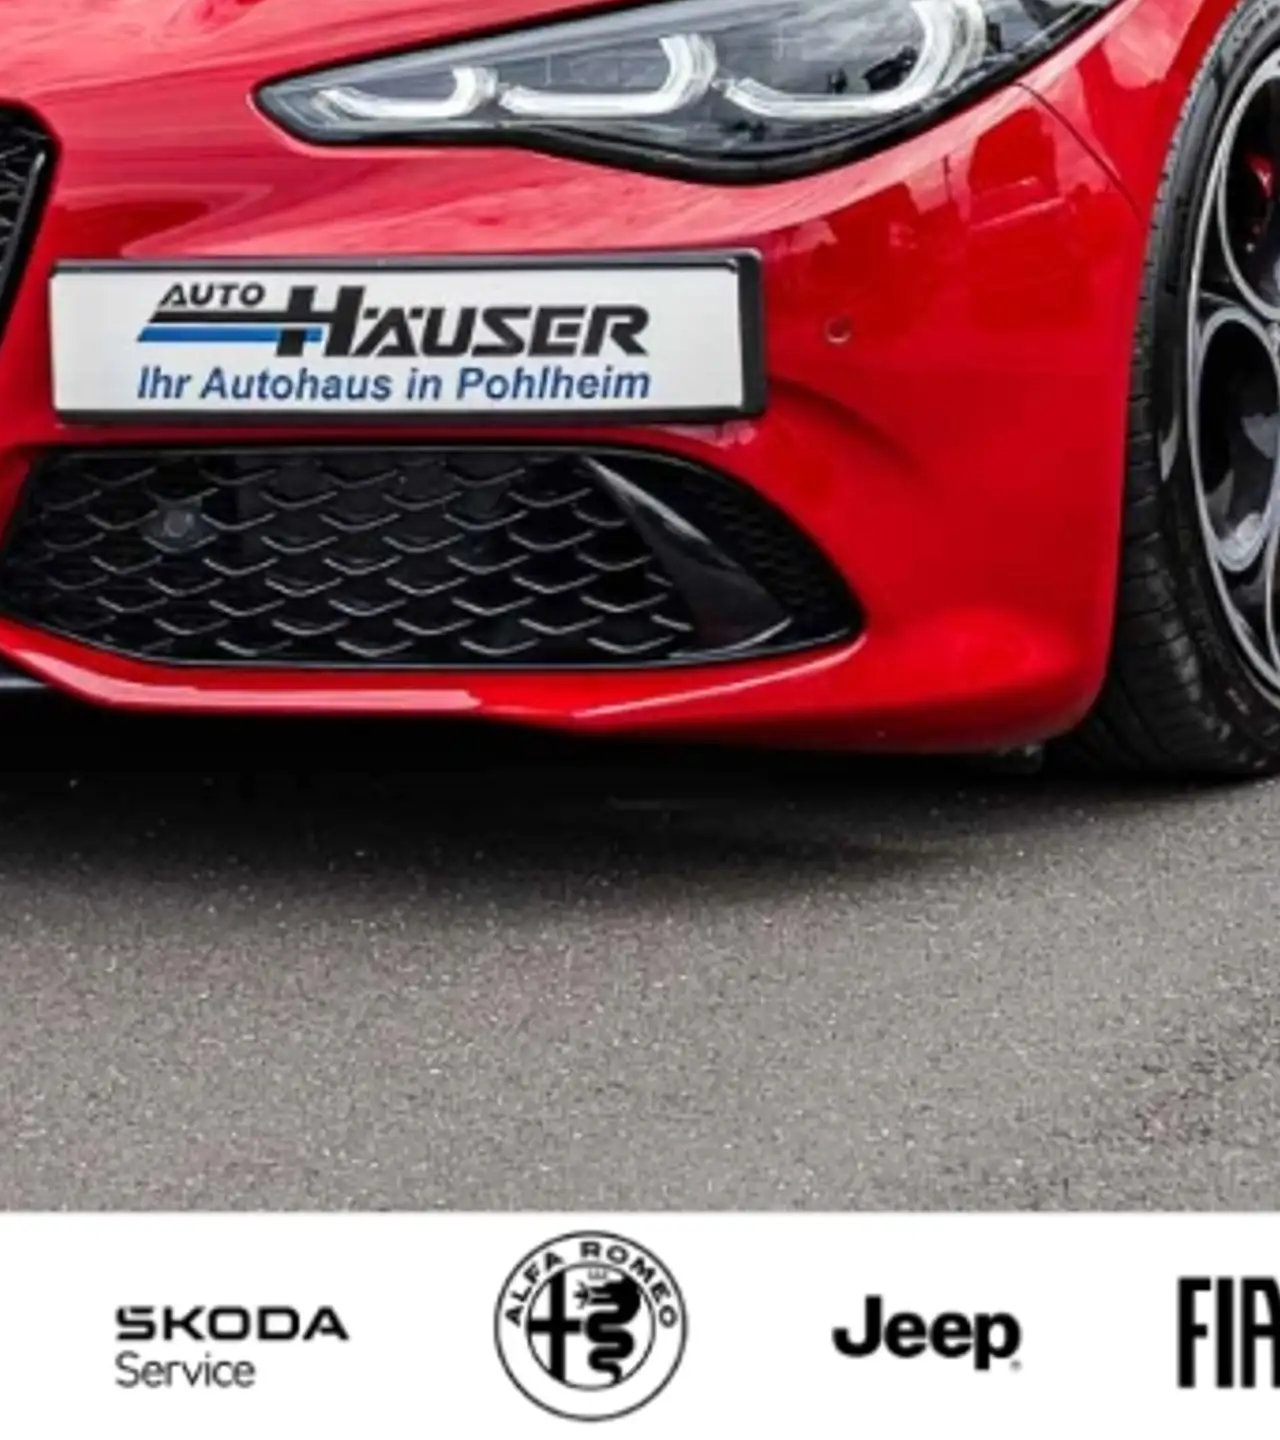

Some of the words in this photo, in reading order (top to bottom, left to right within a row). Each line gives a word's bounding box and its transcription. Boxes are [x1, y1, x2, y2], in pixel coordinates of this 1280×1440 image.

[157, 282, 267, 307] AUTO
[275, 284, 650, 358] HÄUSER
[136, 365, 193, 400] Ihr
[199, 366, 393, 401] Autohaus
[406, 368, 443, 401] in
[456, 365, 652, 401] Pohlheim
